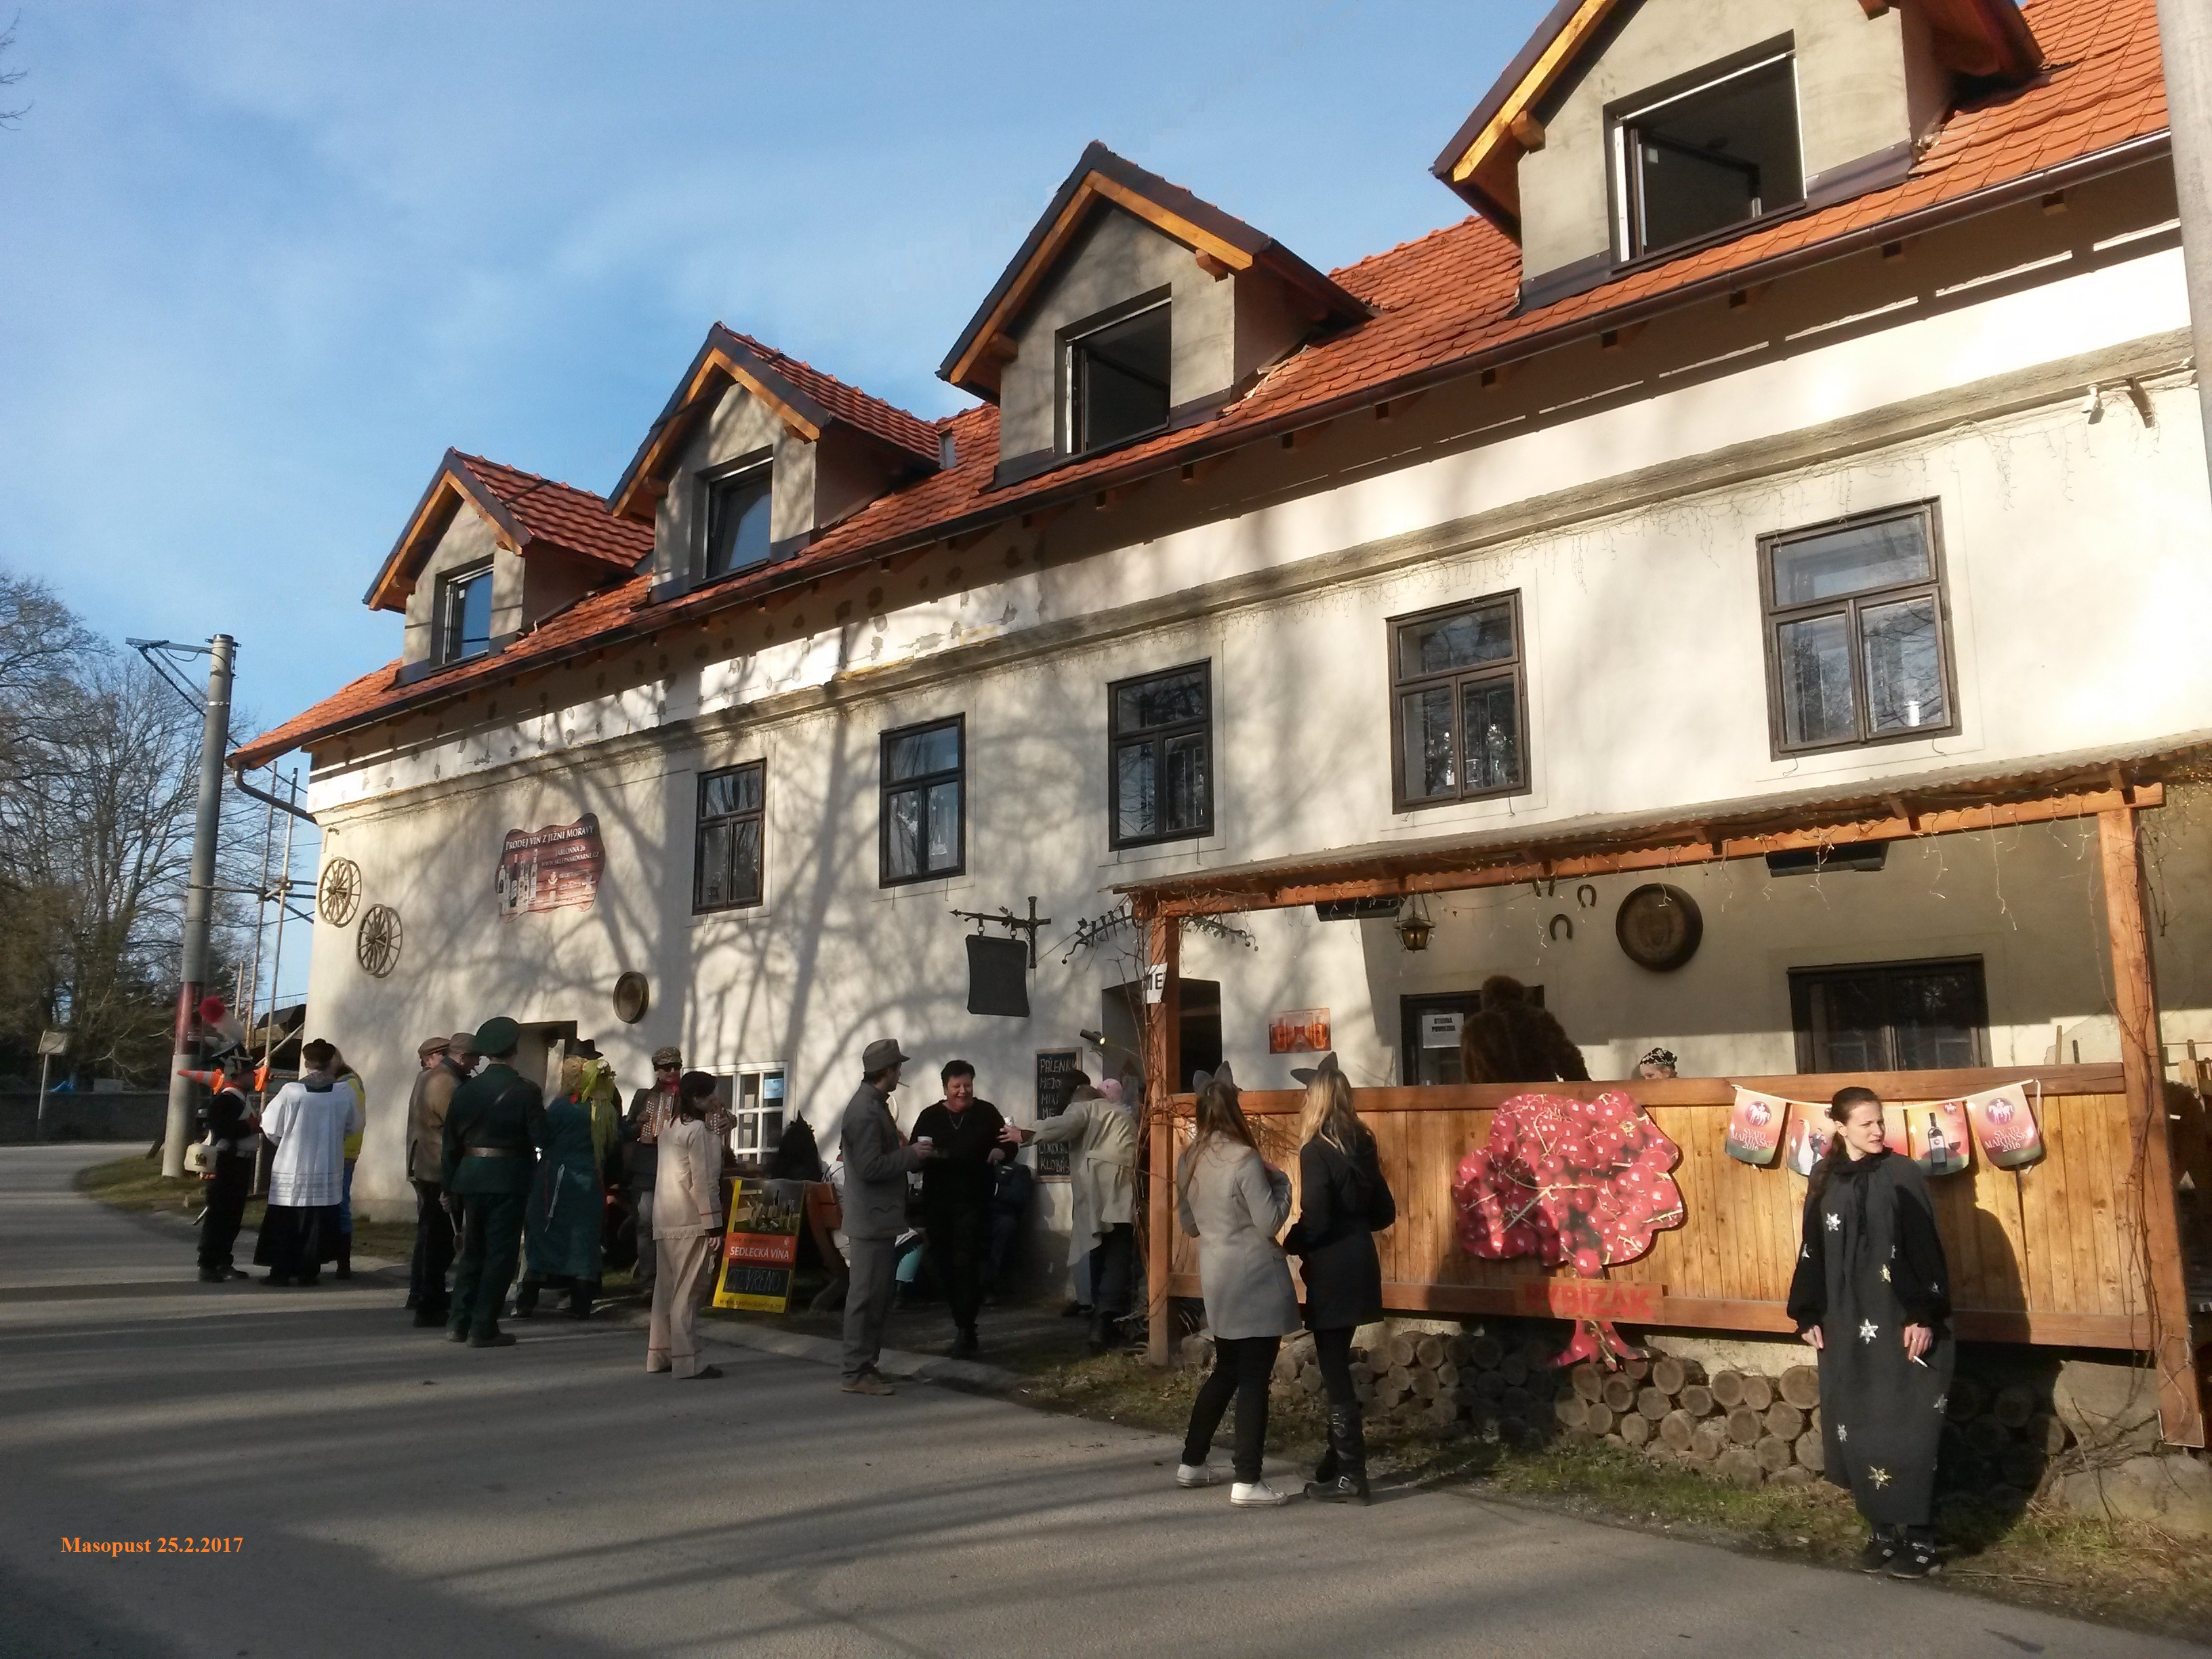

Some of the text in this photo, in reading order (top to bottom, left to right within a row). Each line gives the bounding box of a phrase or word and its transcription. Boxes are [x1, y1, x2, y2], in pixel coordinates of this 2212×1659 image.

[506, 838, 529, 851] PRODEJ
[542, 834, 547, 843] Z
[548, 829, 565, 844] JIŽNÍ
[566, 825, 594, 838] MORAVY
[1742, 1142, 1759, 1151] 2016
[2002, 1142, 2021, 1153] 2016
[730, 1246, 789, 1259] SEDLECKÁ VÍNA
[1523, 1281, 1654, 1319] RYBÍZÁK
